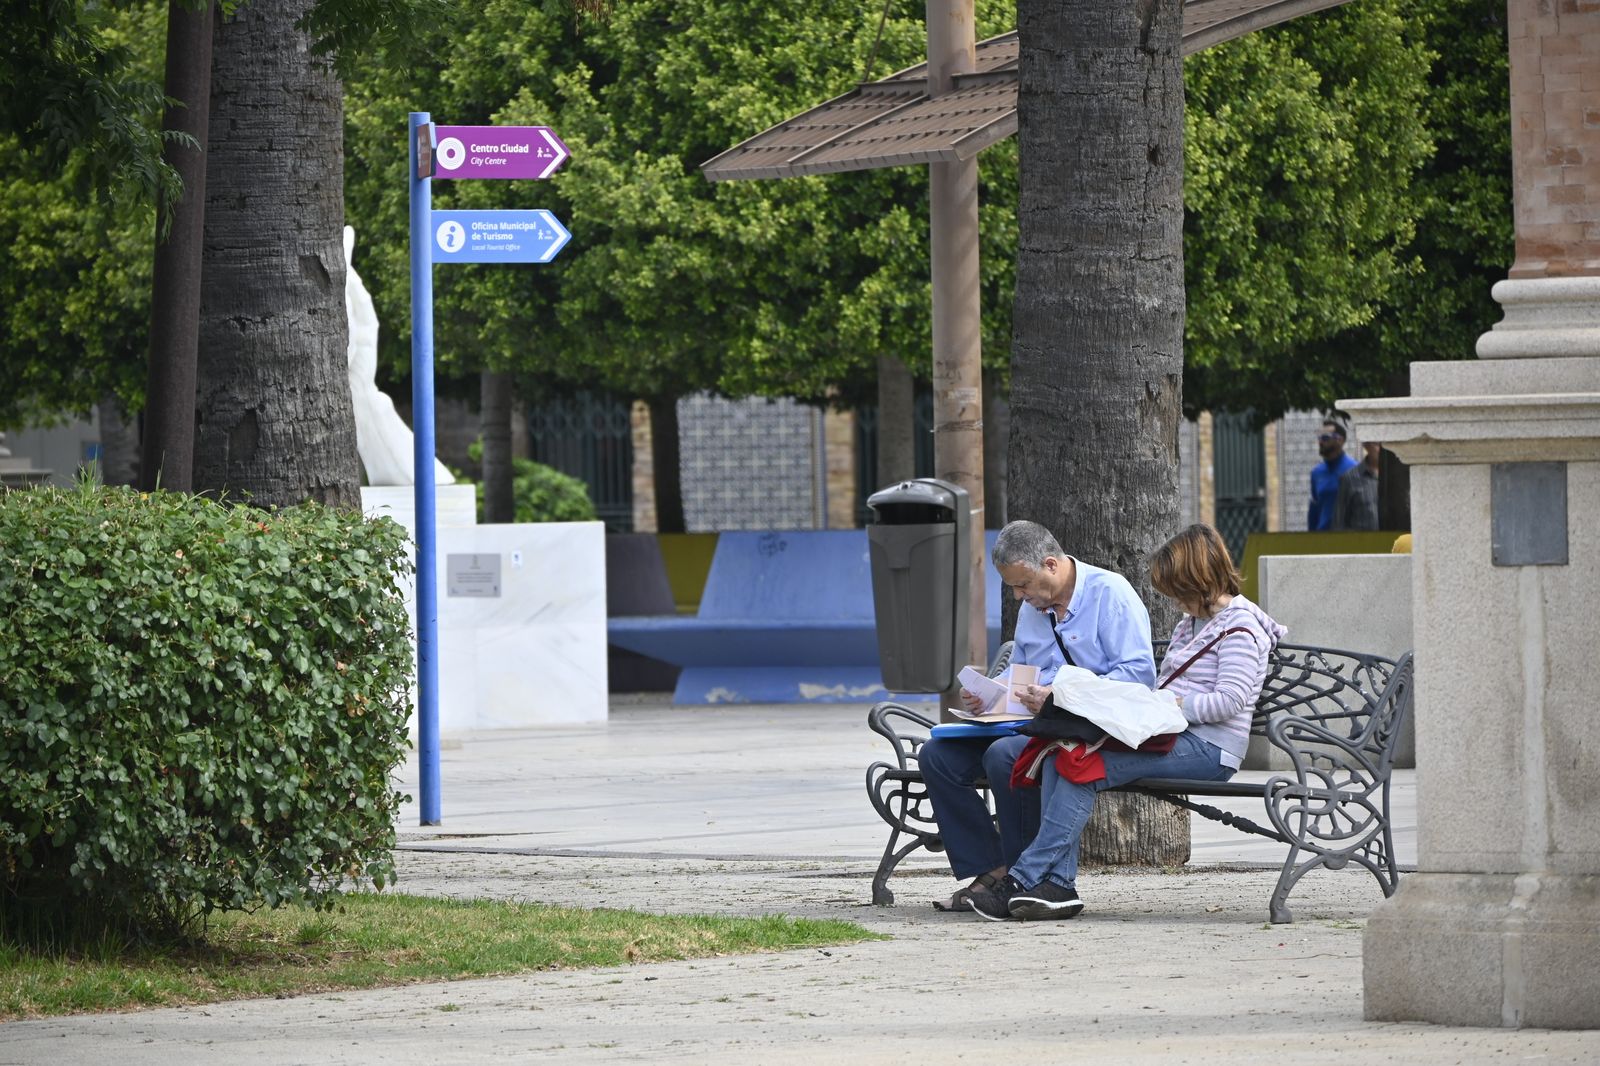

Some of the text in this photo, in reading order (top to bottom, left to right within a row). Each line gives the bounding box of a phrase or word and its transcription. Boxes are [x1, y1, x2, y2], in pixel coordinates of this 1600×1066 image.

[470, 143, 529, 153] Centro Ciudad
[470, 157, 507, 166] City Centre
[471, 222, 536, 232] Oficina Municipal
[471, 232, 513, 240] de Turismo
